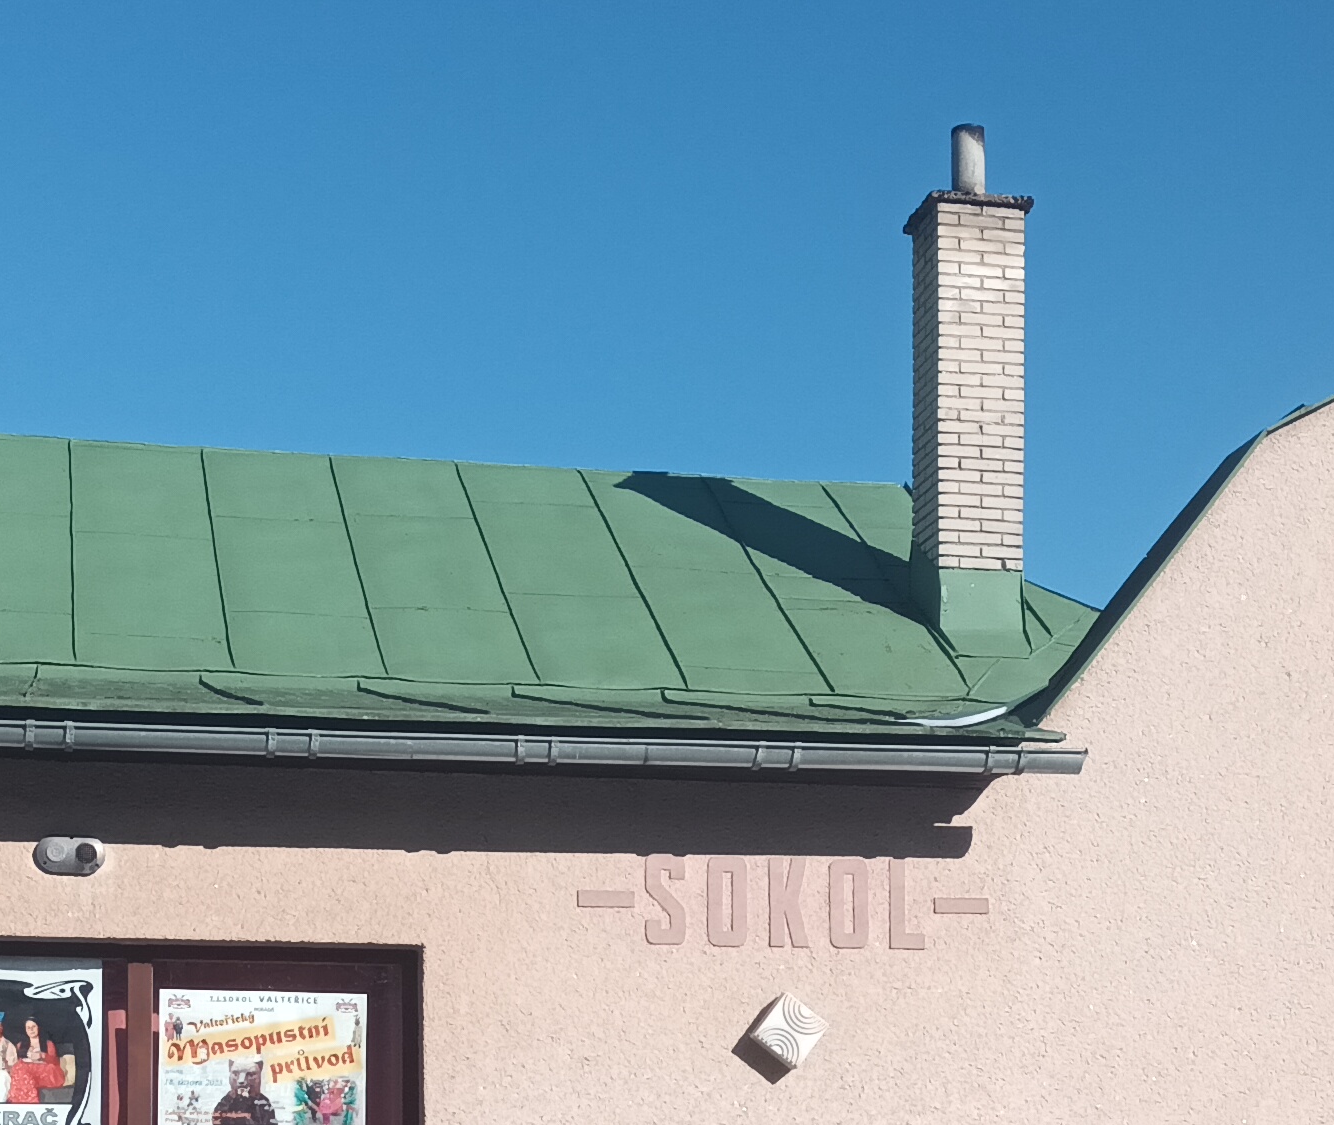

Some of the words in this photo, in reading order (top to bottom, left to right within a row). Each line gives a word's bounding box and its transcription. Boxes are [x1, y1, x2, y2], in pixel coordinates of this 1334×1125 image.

[259, 995, 318, 1005] VALTEŘICE
[187, 1011, 255, 1033] Valteřický
[167, 1017, 330, 1065] Masopustní
[270, 1045, 355, 1083] průvod
